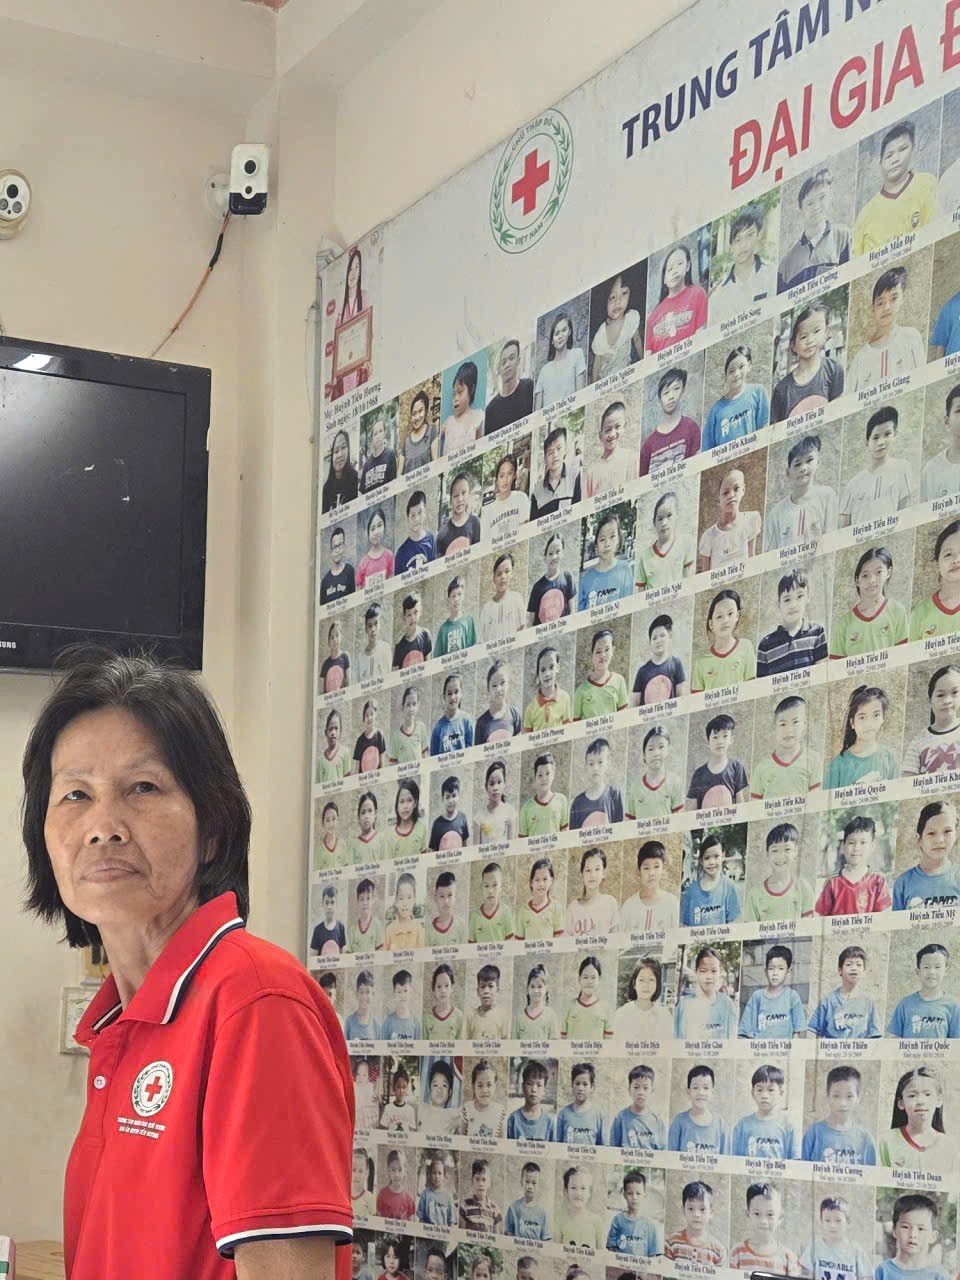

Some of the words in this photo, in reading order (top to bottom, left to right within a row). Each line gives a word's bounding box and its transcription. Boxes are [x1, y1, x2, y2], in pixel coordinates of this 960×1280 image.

[622, 50, 739, 160] TRUNG
[748, 0, 831, 80] TÂM
[729, 83, 814, 191] ĐẠI
[829, 24, 925, 130] GIA
